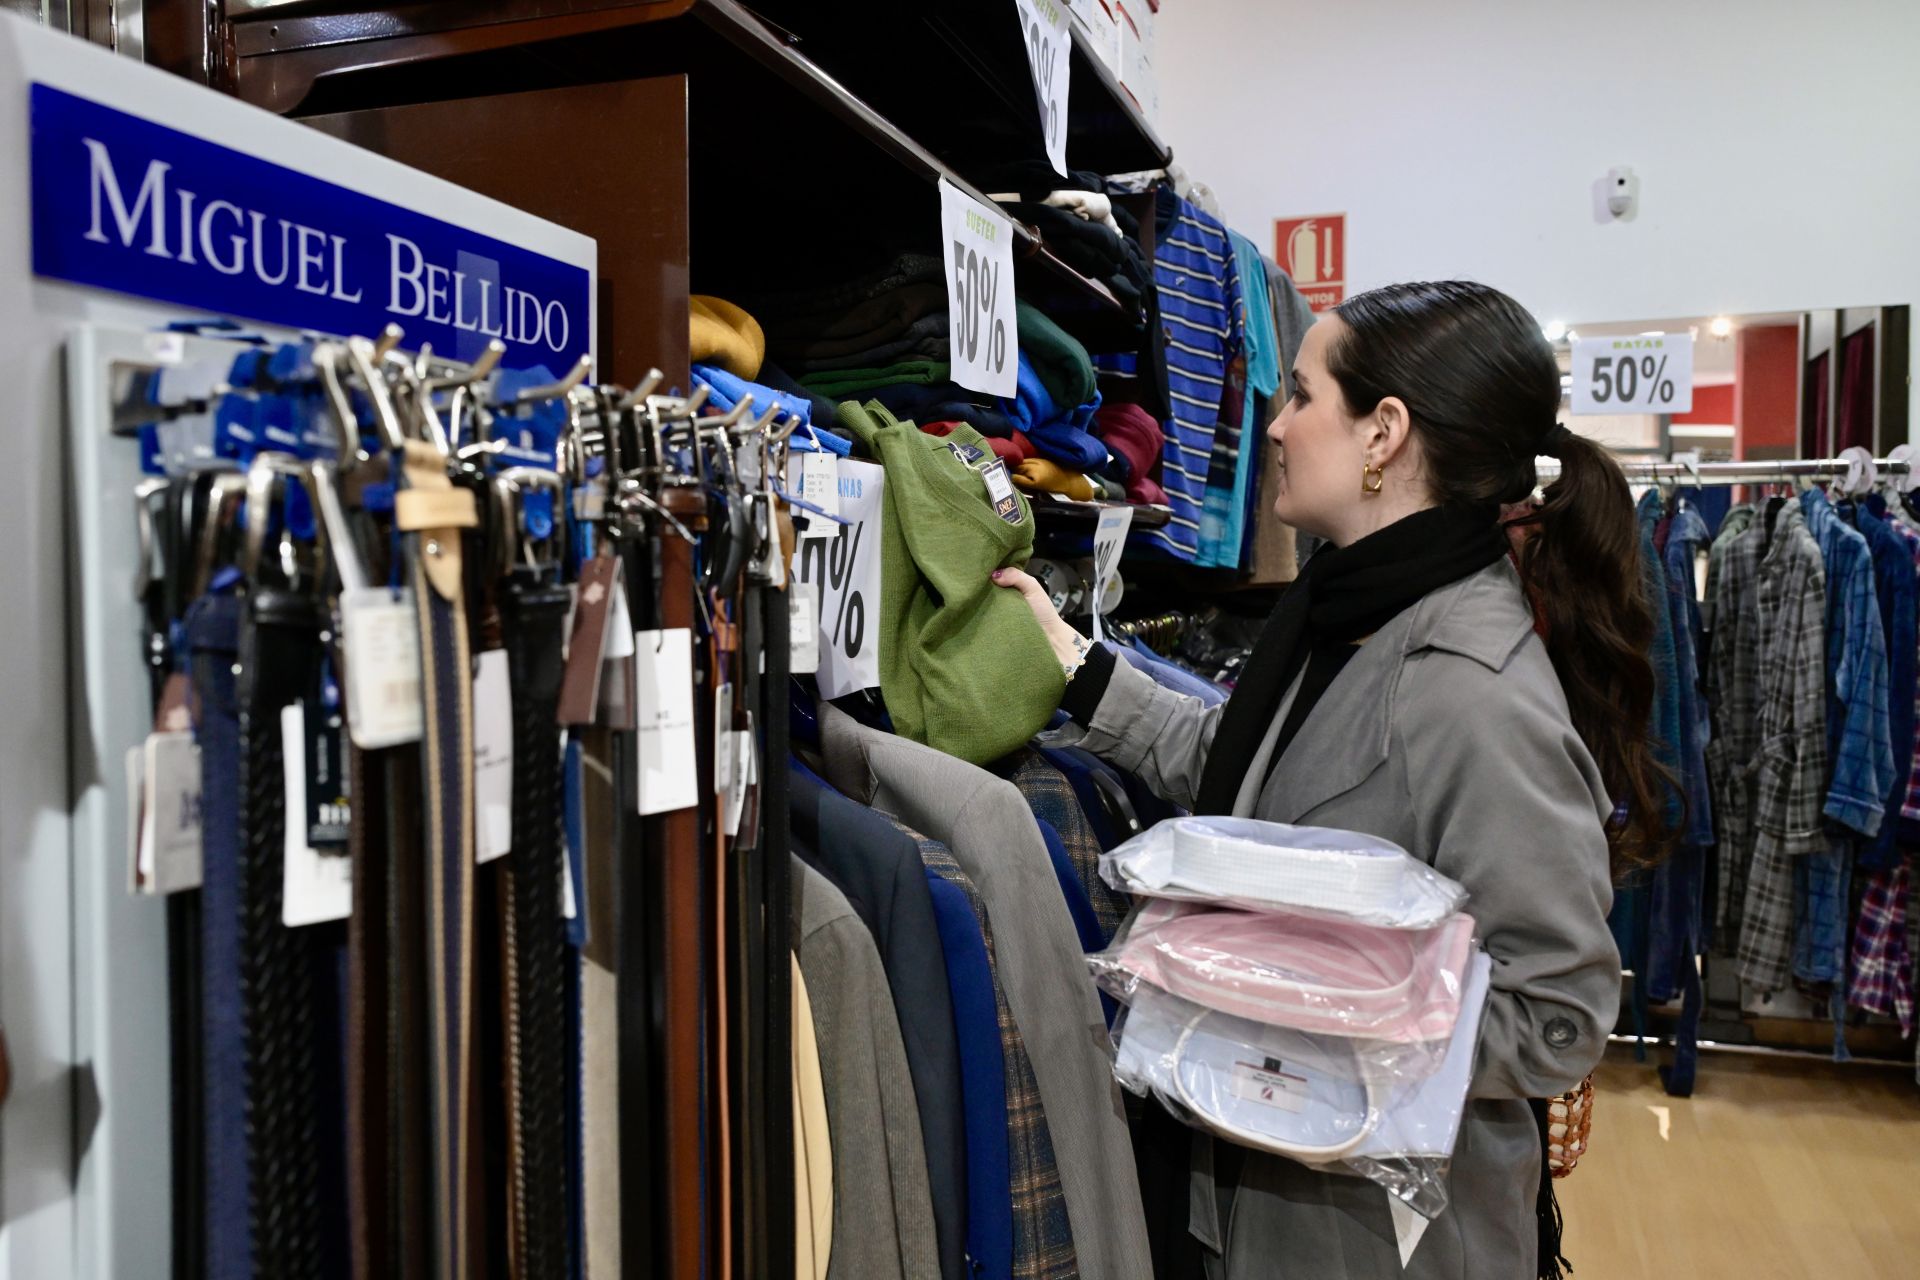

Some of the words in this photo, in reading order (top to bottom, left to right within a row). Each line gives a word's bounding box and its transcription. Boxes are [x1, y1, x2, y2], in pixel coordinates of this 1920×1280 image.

[966, 208, 996, 243] SUETER
[953, 240, 1006, 374] 50%
[1591, 354, 1674, 404] 50%
